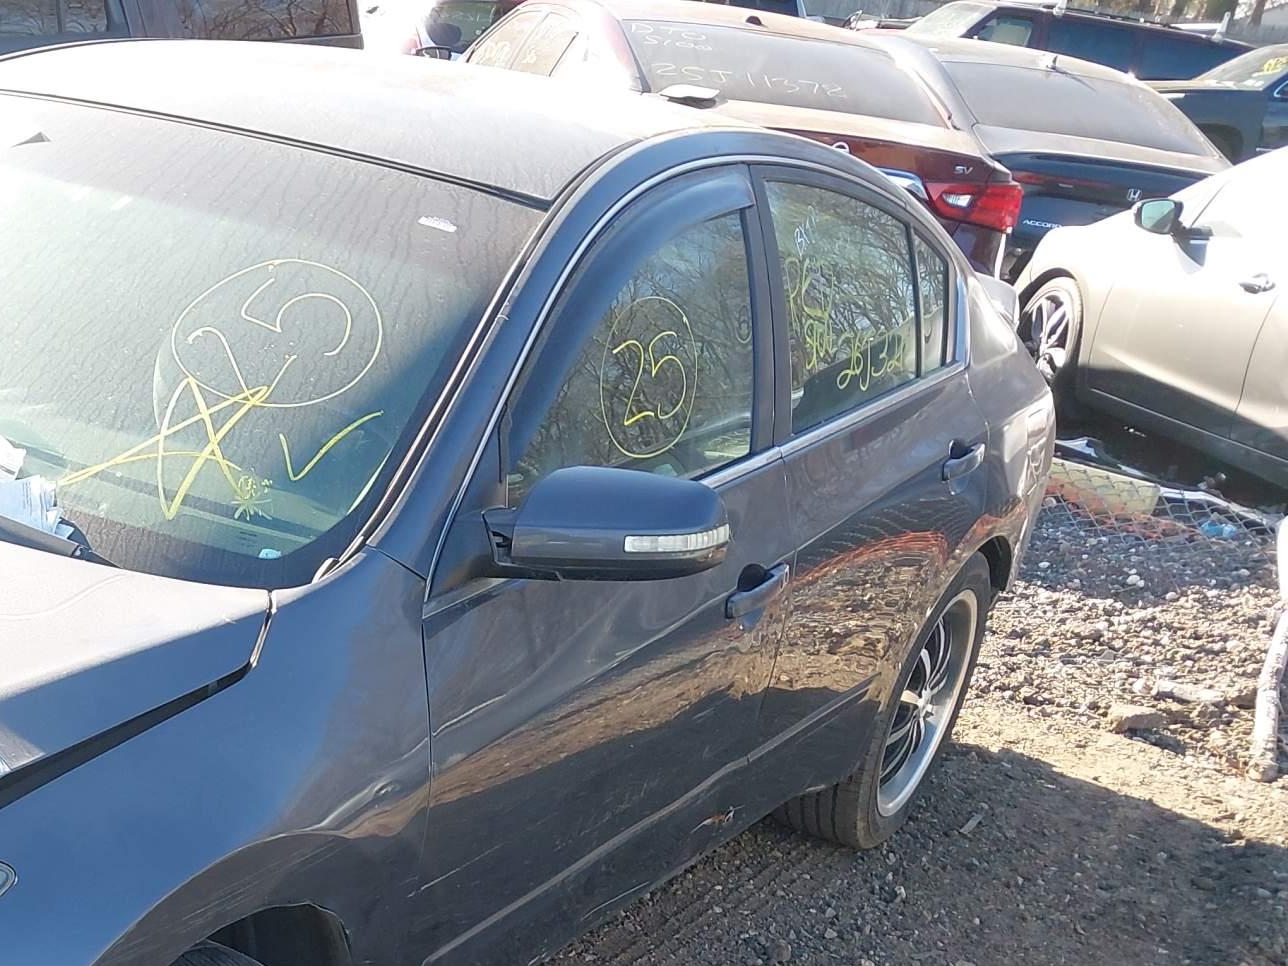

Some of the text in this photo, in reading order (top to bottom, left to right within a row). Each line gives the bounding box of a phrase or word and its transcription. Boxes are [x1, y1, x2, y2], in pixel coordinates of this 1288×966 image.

[953, 165, 975, 175] SV
[186, 277, 353, 404] 25
[612, 330, 687, 426] 25
